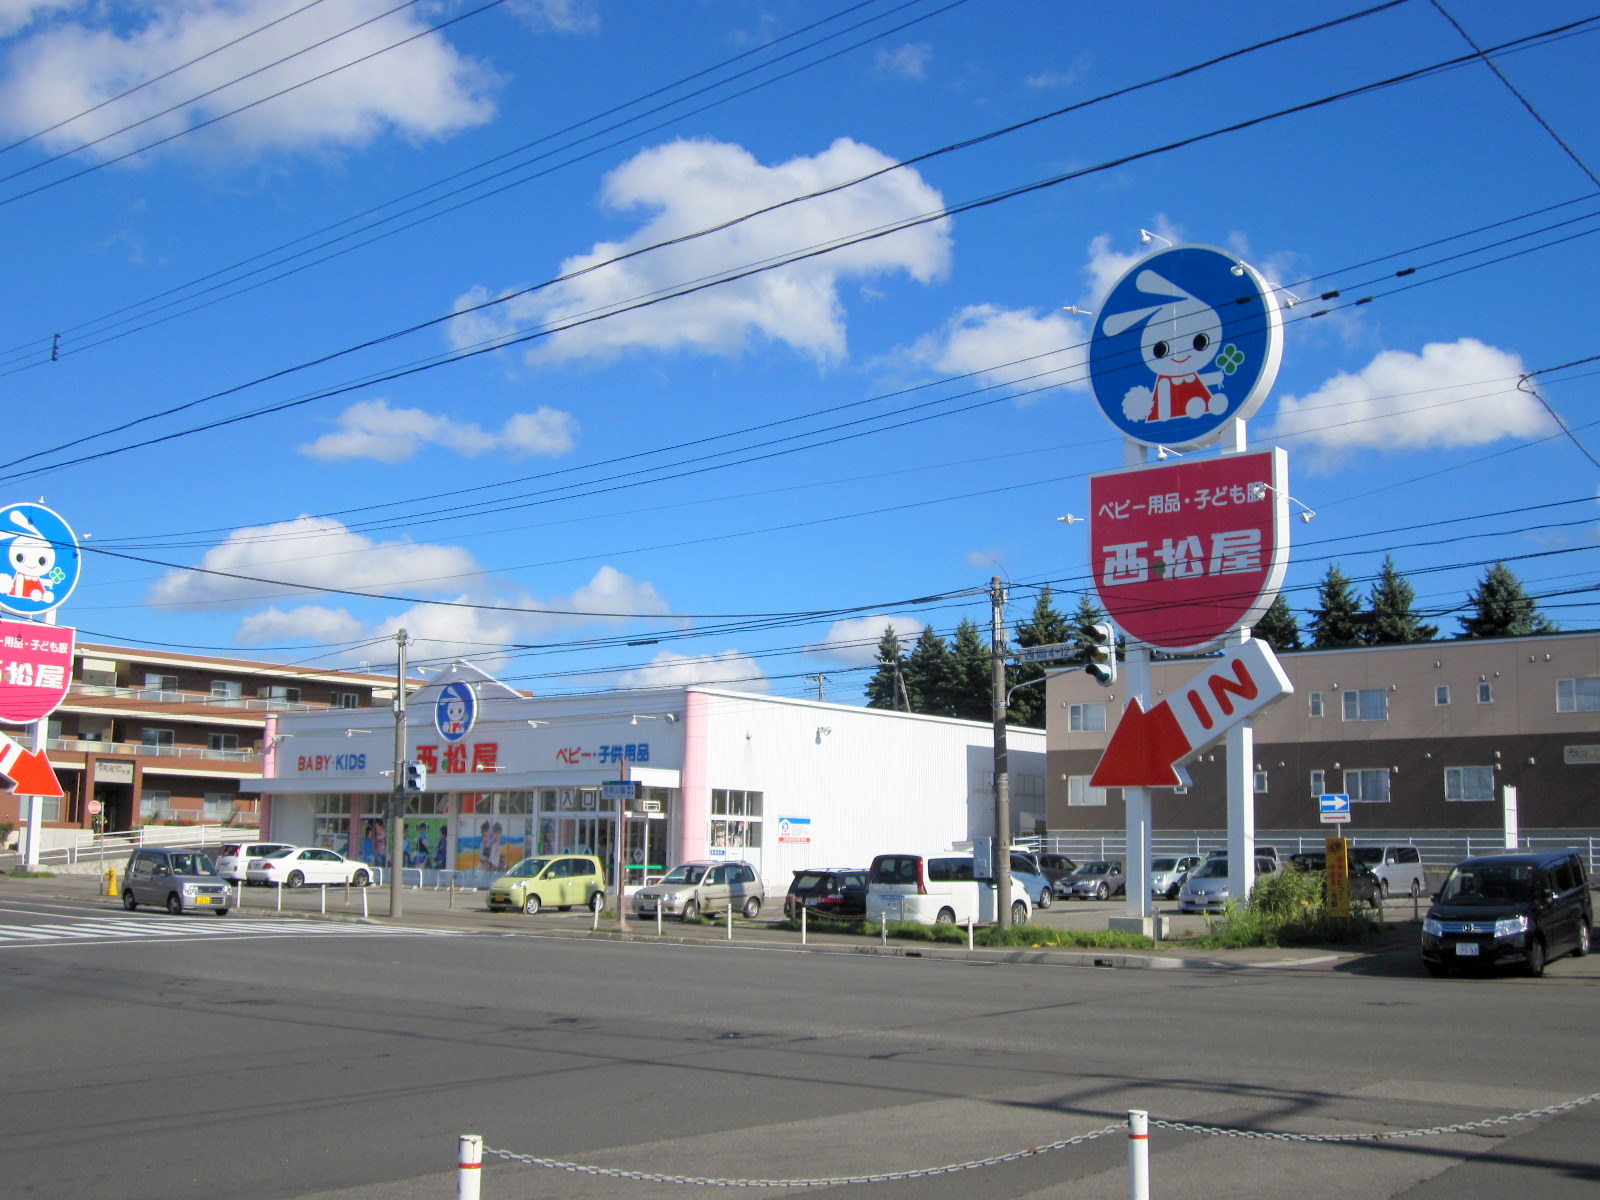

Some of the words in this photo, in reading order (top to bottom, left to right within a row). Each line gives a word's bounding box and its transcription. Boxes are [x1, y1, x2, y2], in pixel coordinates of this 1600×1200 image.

[1102, 528, 1261, 587] 西松屋
[0, 660, 64, 689] 松屋
[1187, 658, 1258, 730] IN
